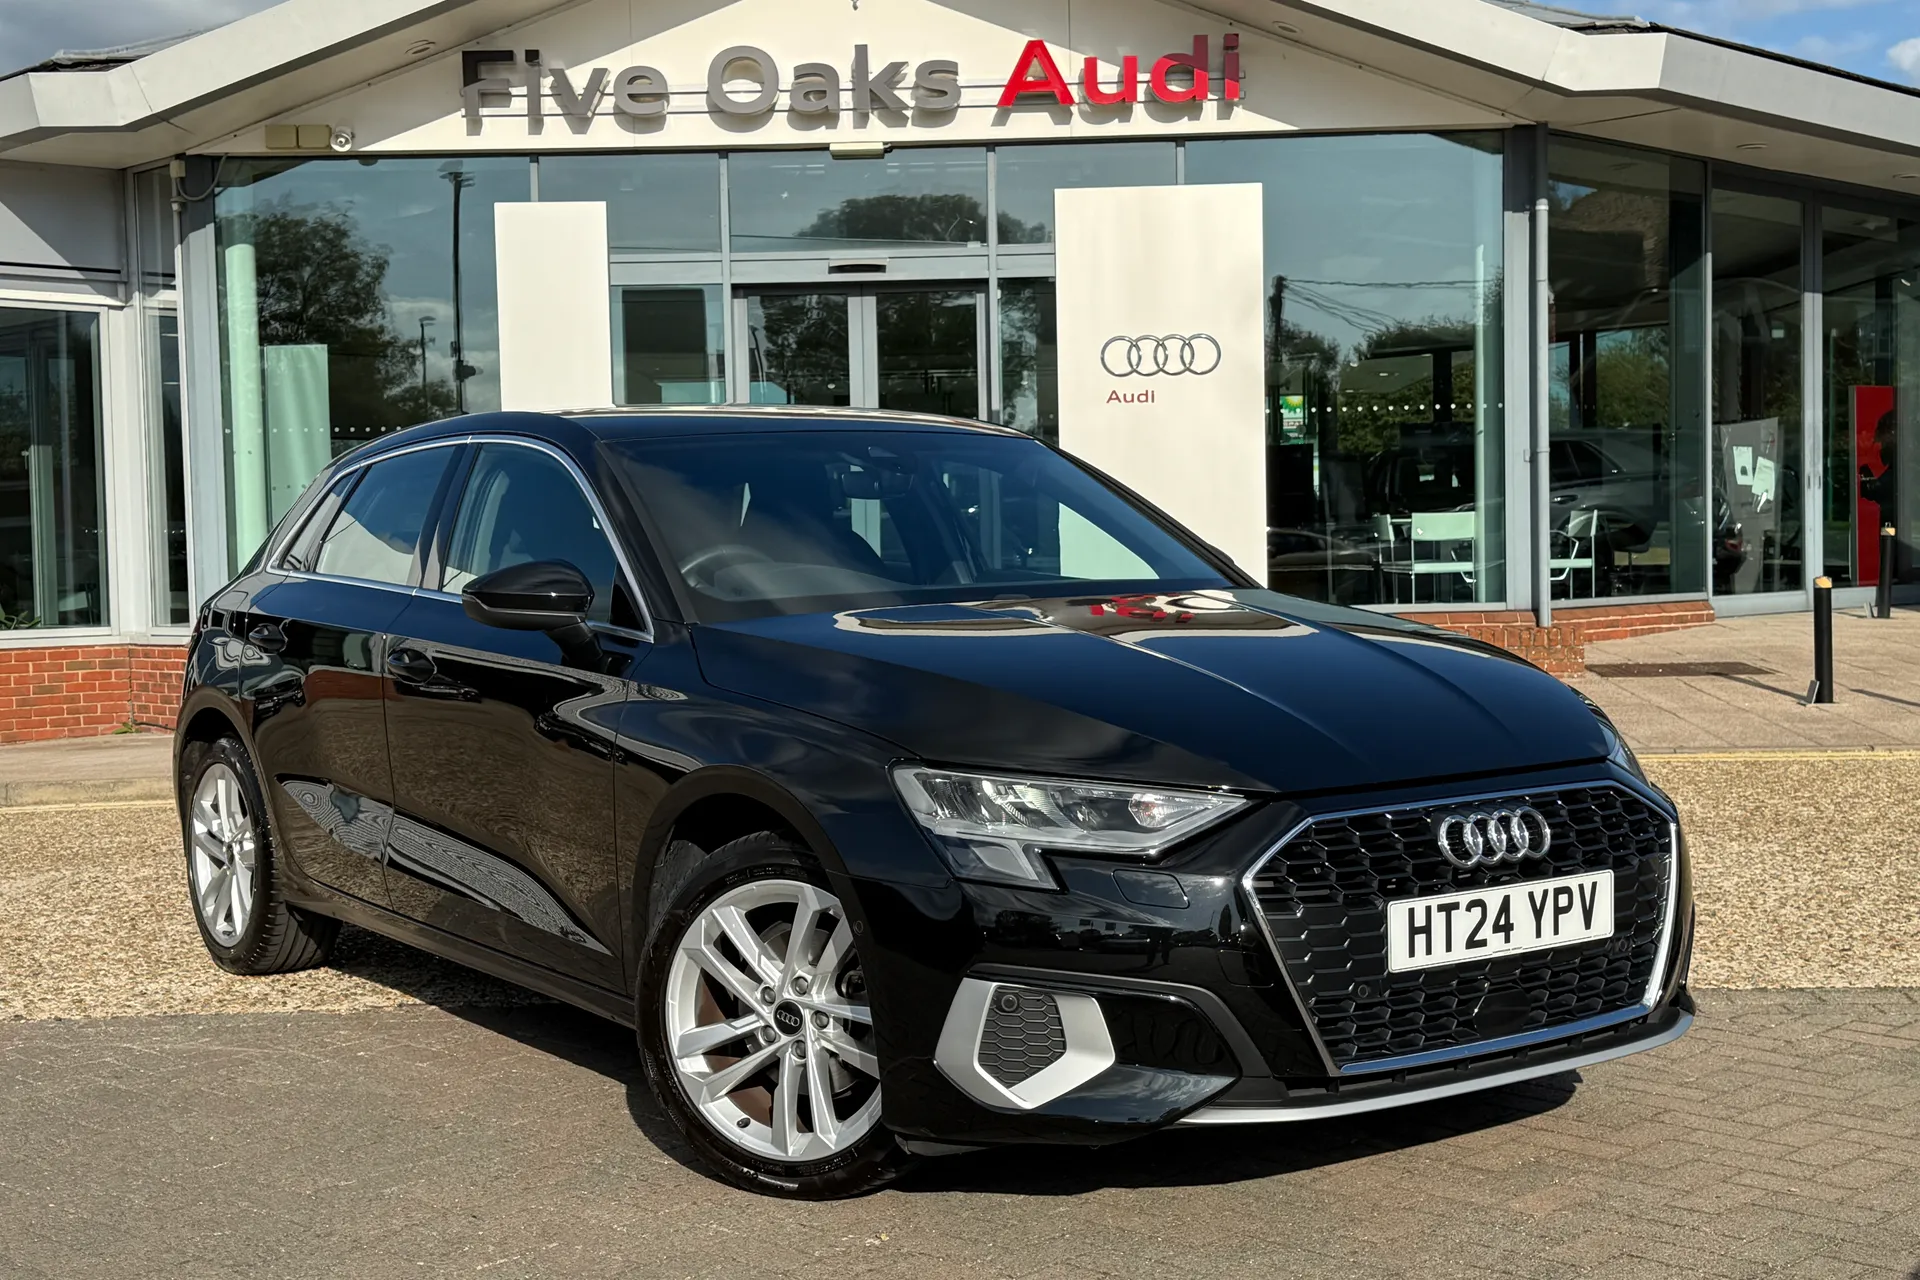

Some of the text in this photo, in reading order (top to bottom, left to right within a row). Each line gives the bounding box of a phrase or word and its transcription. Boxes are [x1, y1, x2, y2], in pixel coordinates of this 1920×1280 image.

[462, 33, 1240, 118] Five Oaks Audi
[1106, 389, 1155, 404] Audi
[1407, 880, 1598, 958] HT24 YPV
